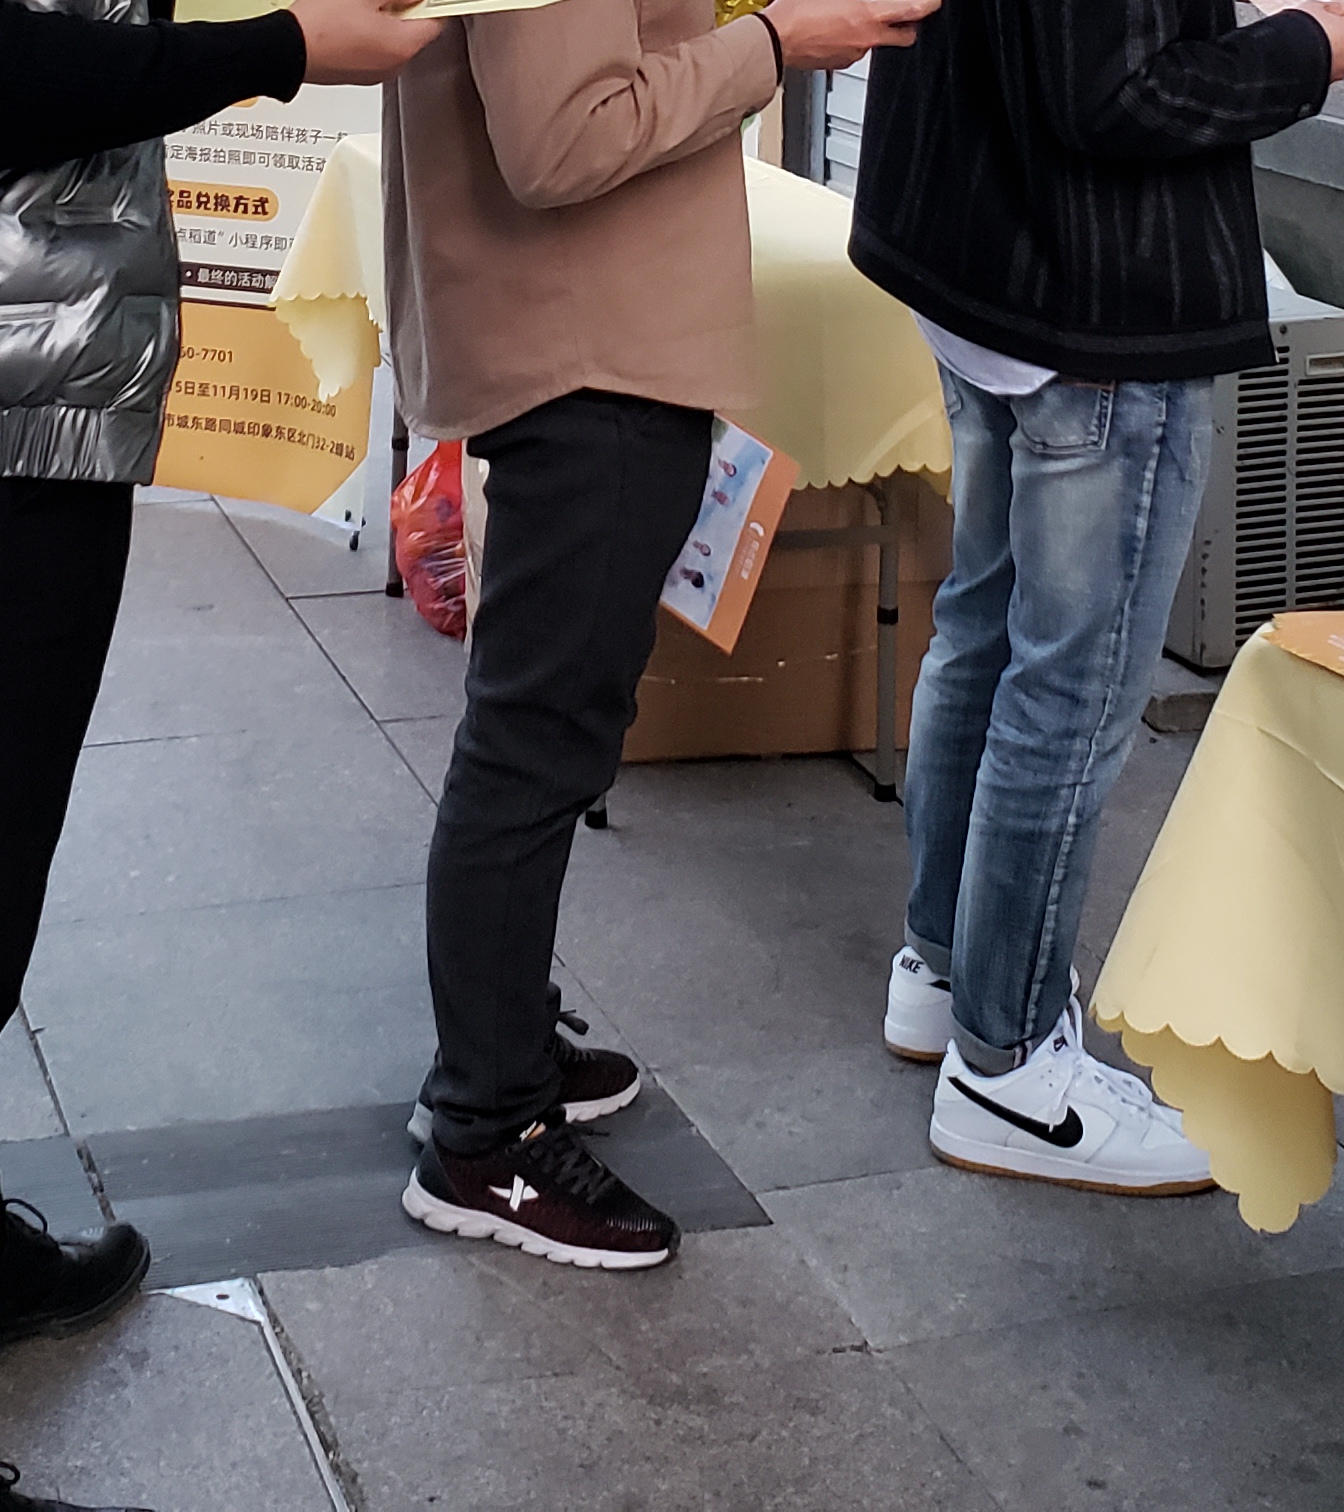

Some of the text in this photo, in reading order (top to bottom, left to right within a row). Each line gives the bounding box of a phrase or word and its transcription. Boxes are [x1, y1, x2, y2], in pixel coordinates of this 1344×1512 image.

[164, 144, 327, 174] 定海报拍照即可领取活动
